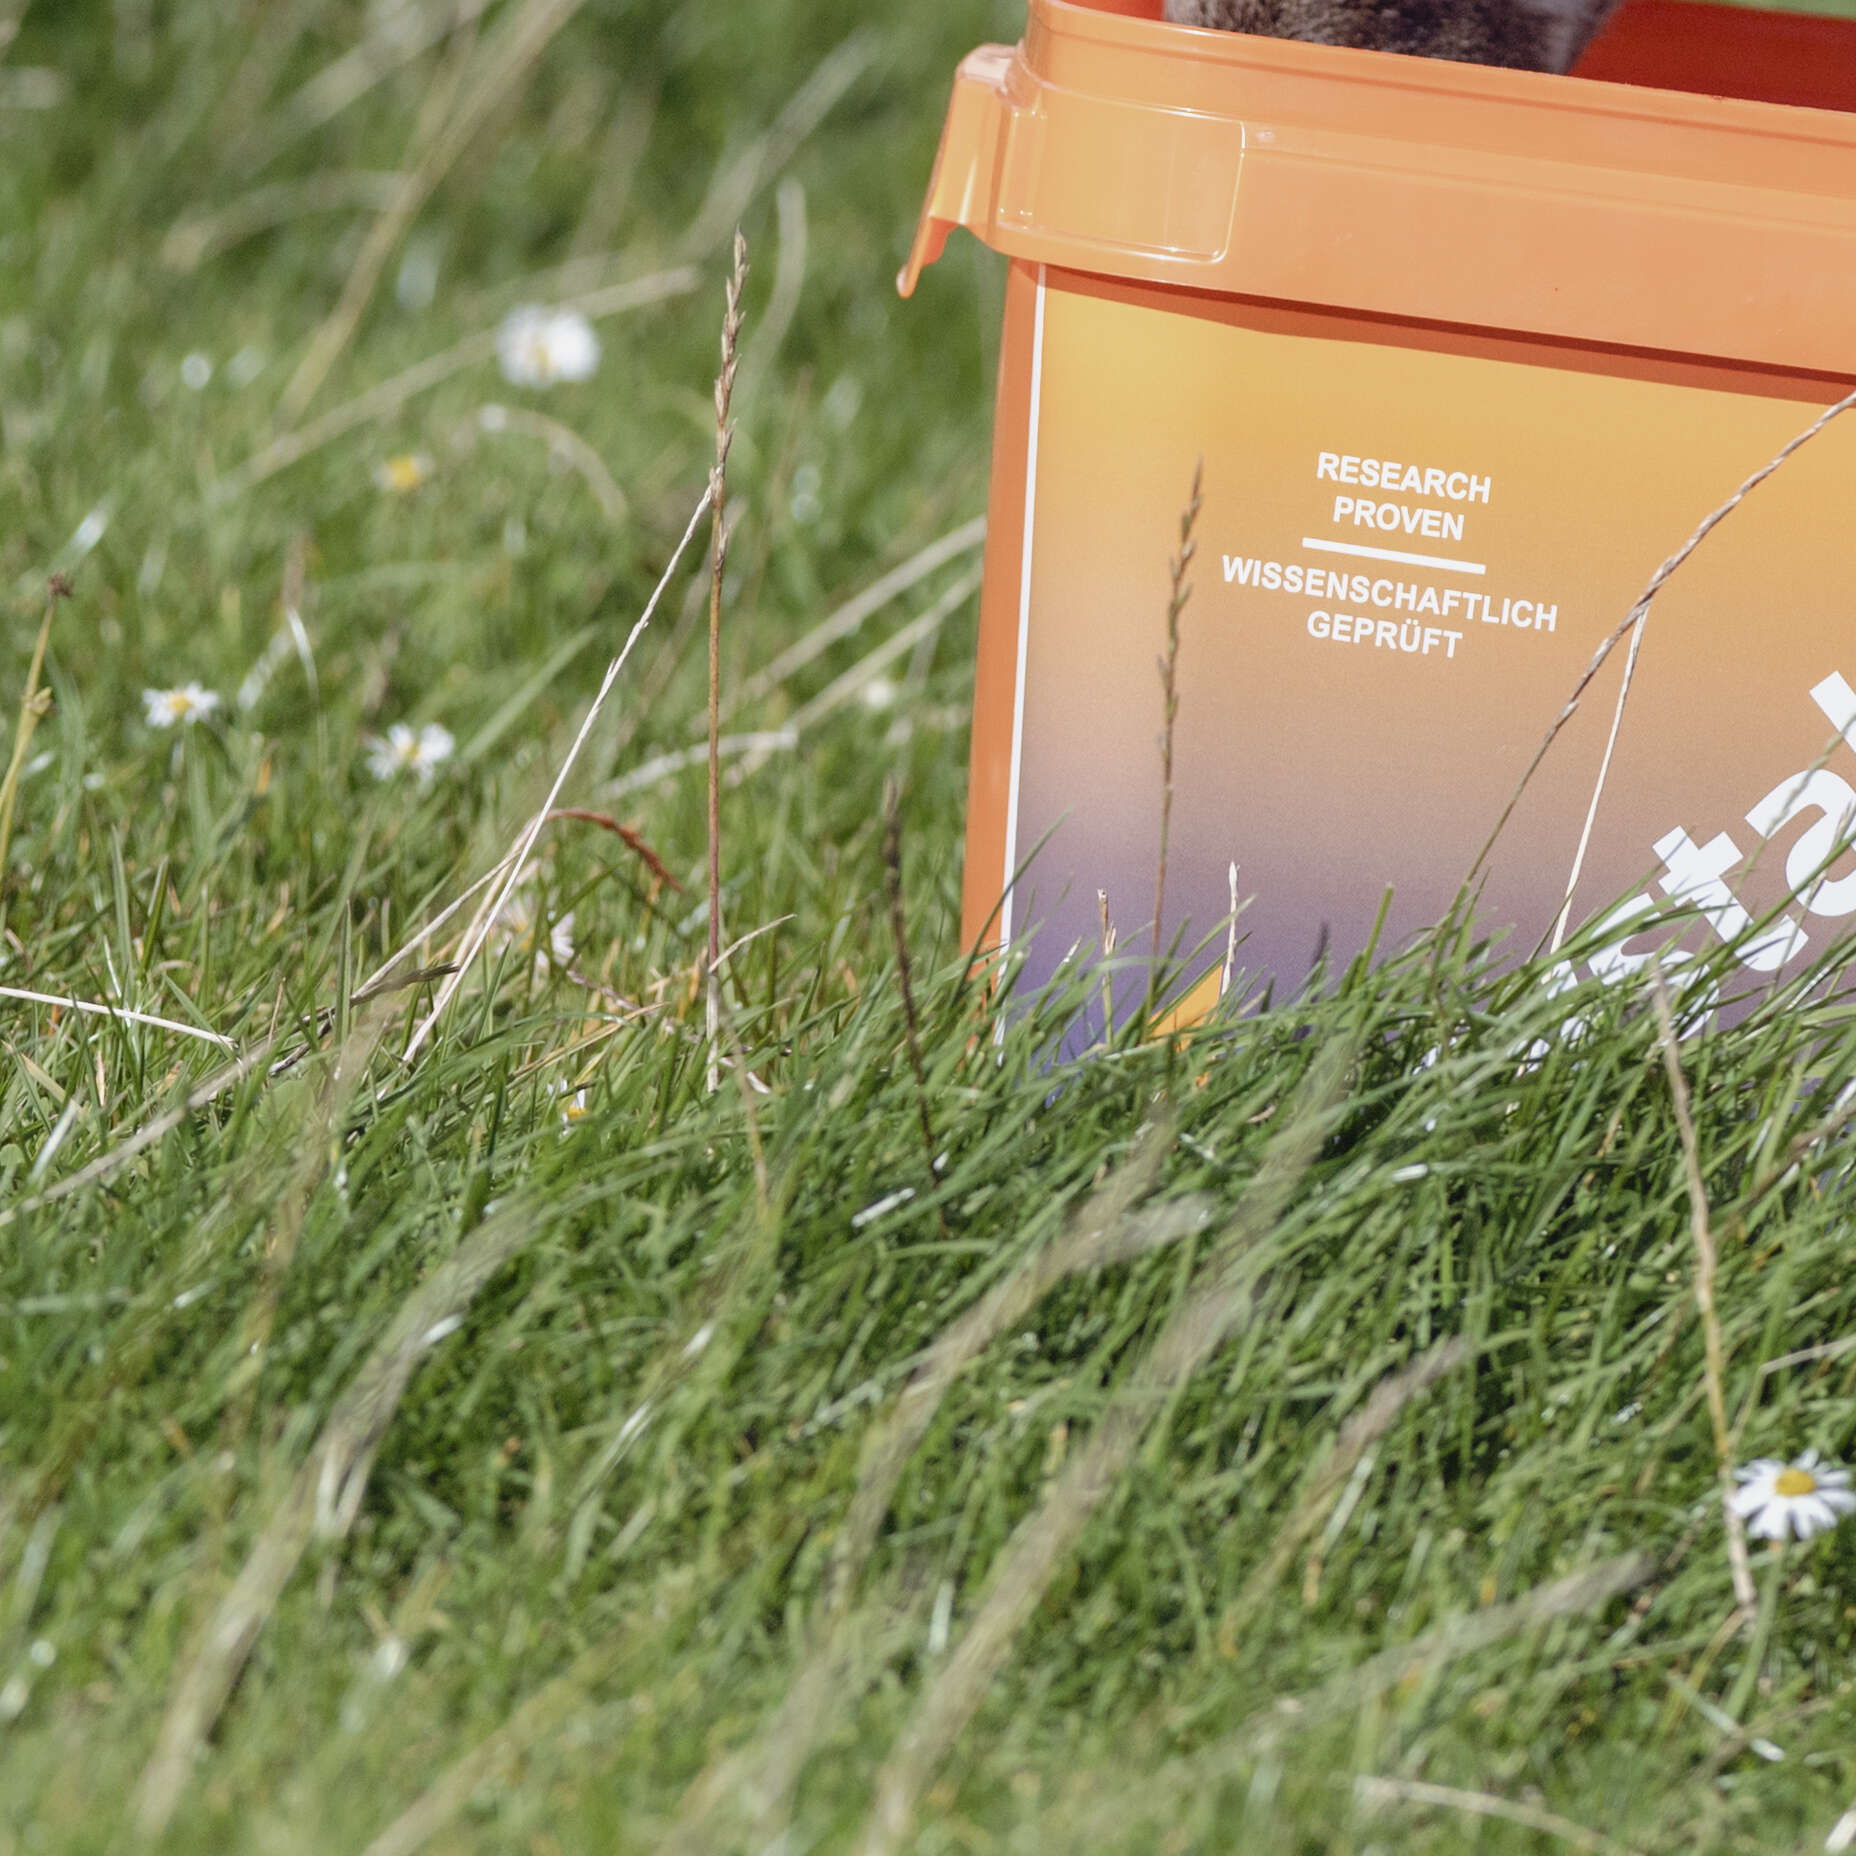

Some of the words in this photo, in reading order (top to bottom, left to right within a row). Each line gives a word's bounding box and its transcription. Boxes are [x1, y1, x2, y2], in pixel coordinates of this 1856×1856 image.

[1316, 451, 1492, 504] RESEARCH
[1333, 495, 1465, 541] PROVEN
[1222, 554, 1559, 633] WISSENSCHAFTLICH
[1306, 610, 1463, 659] GEPRÜFT
